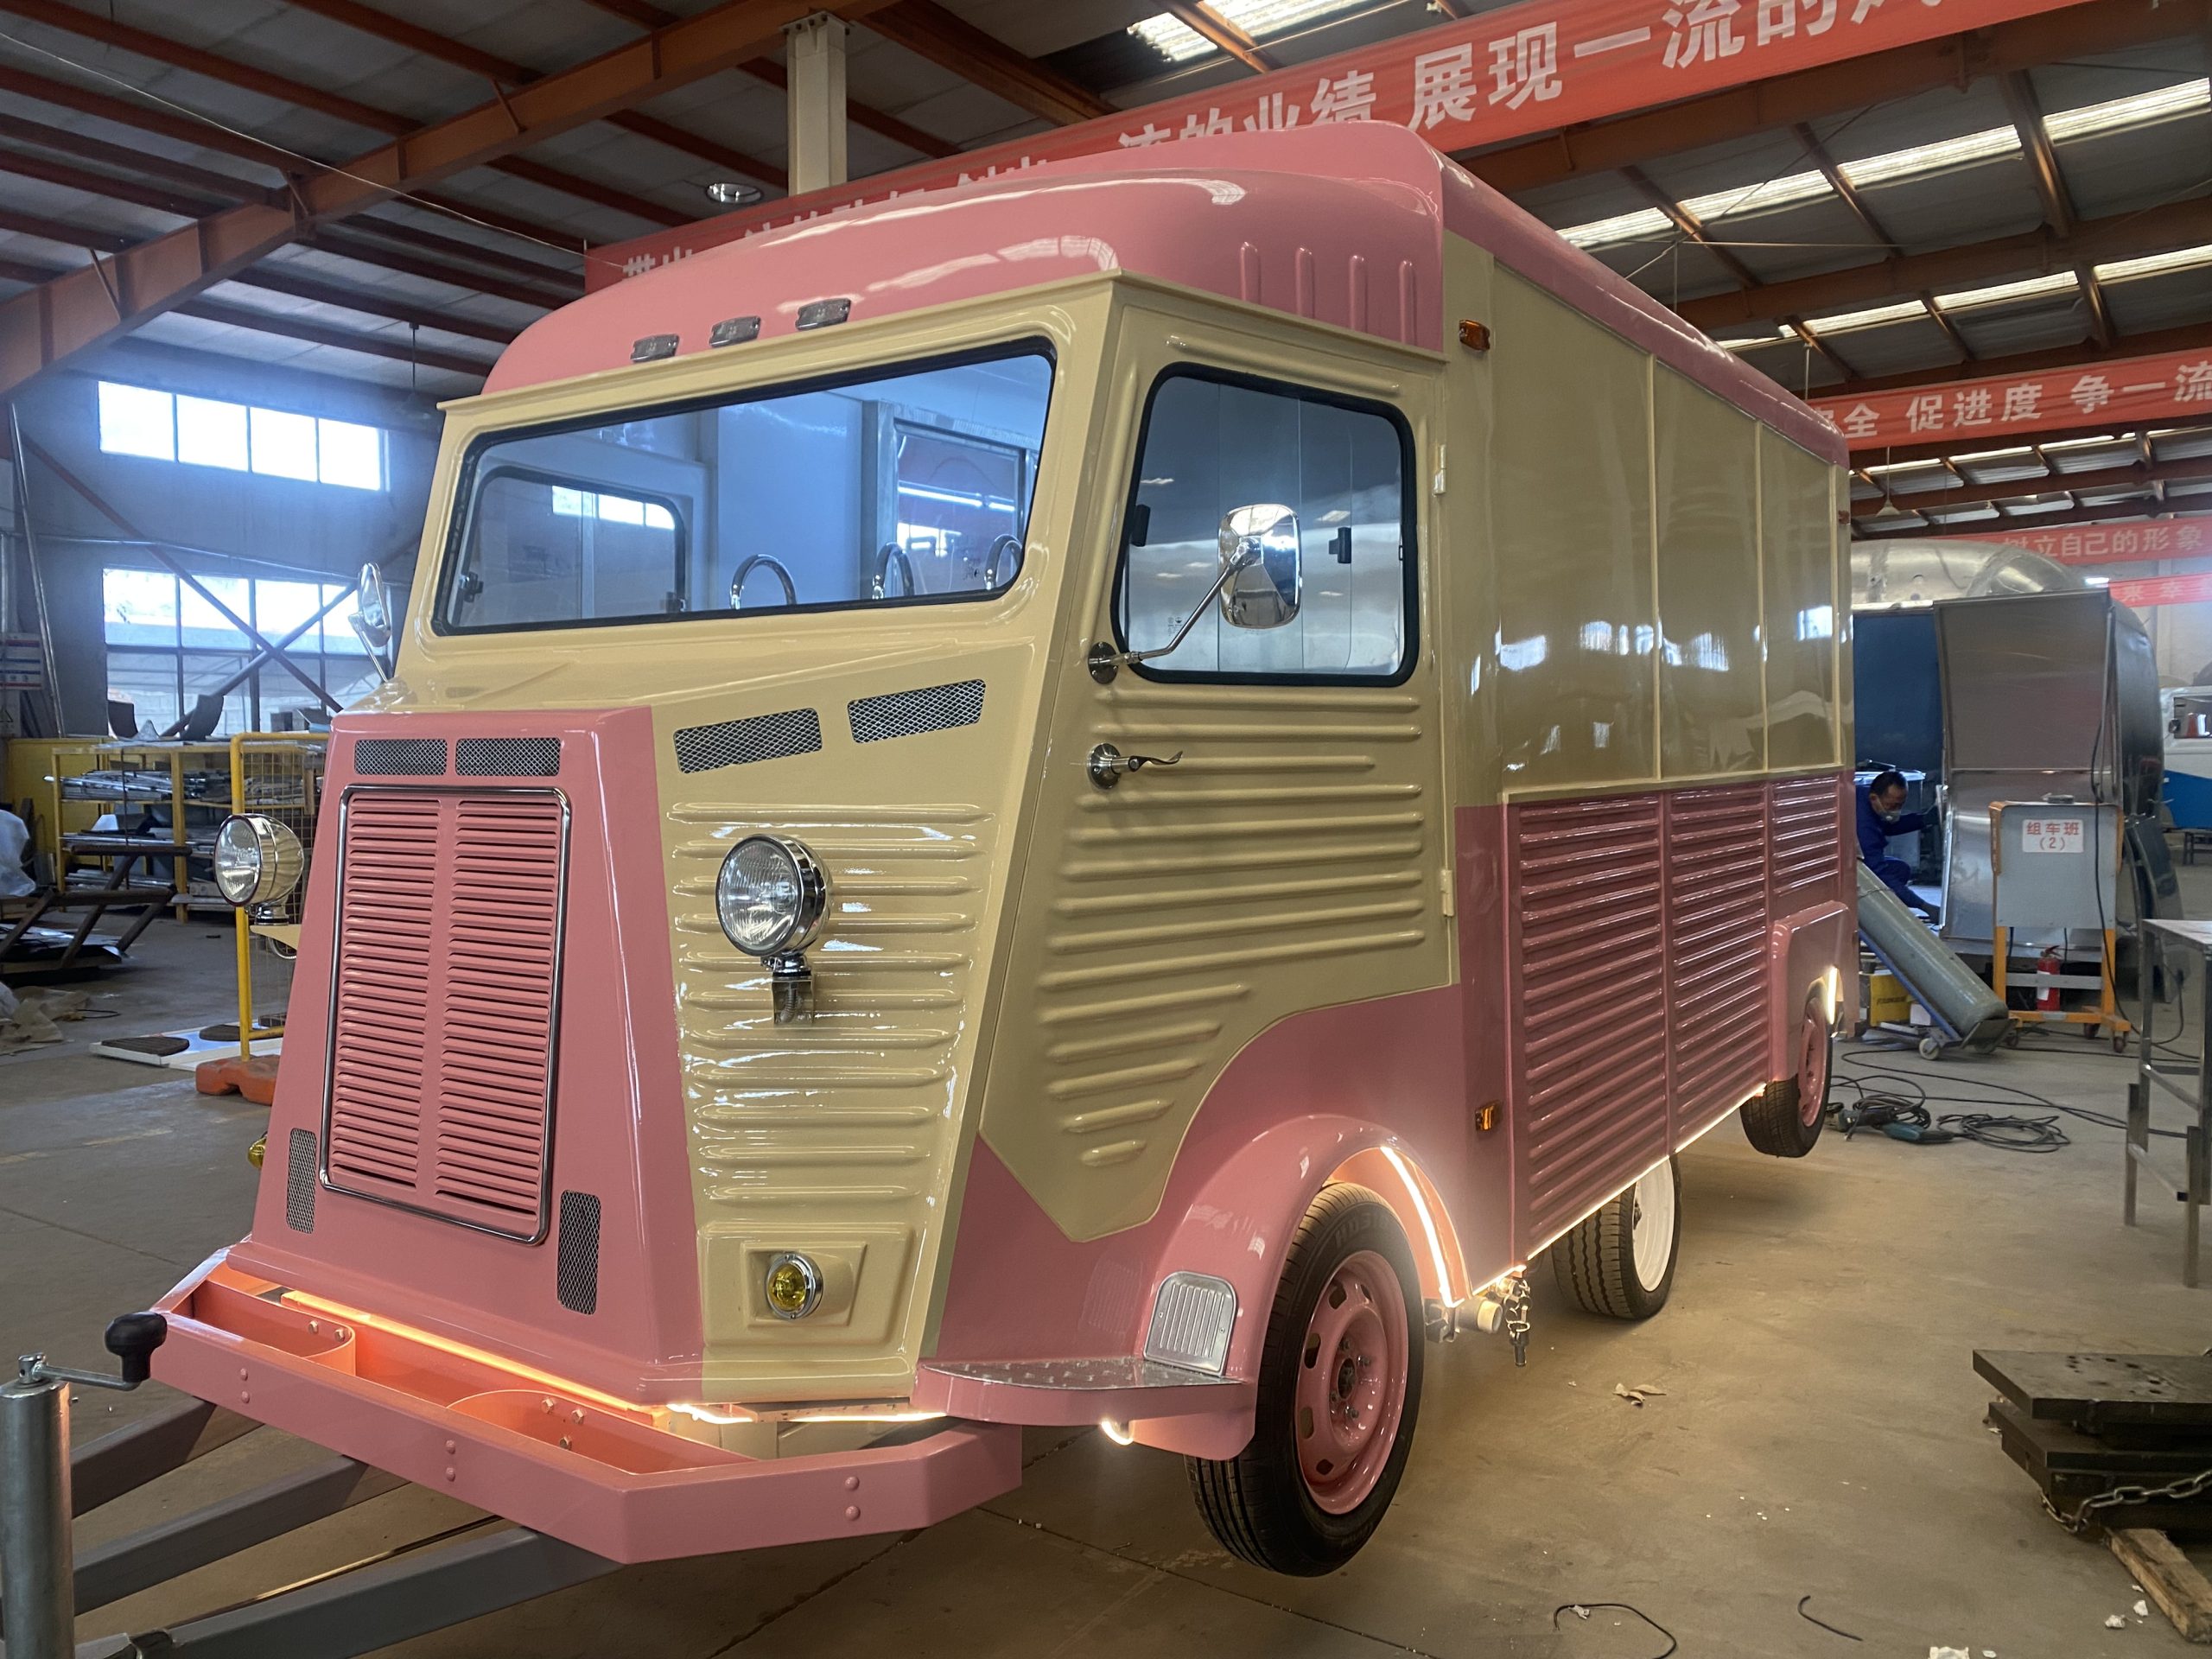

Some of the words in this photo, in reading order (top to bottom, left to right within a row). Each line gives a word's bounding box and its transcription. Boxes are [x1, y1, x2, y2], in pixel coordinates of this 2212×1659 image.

[1408, 0, 1943, 131] 展现一流的
[1905, 383, 2043, 432] 促进度
[2070, 360, 2212, 414] 争一流
[2026, 822, 2079, 836] 组车班
